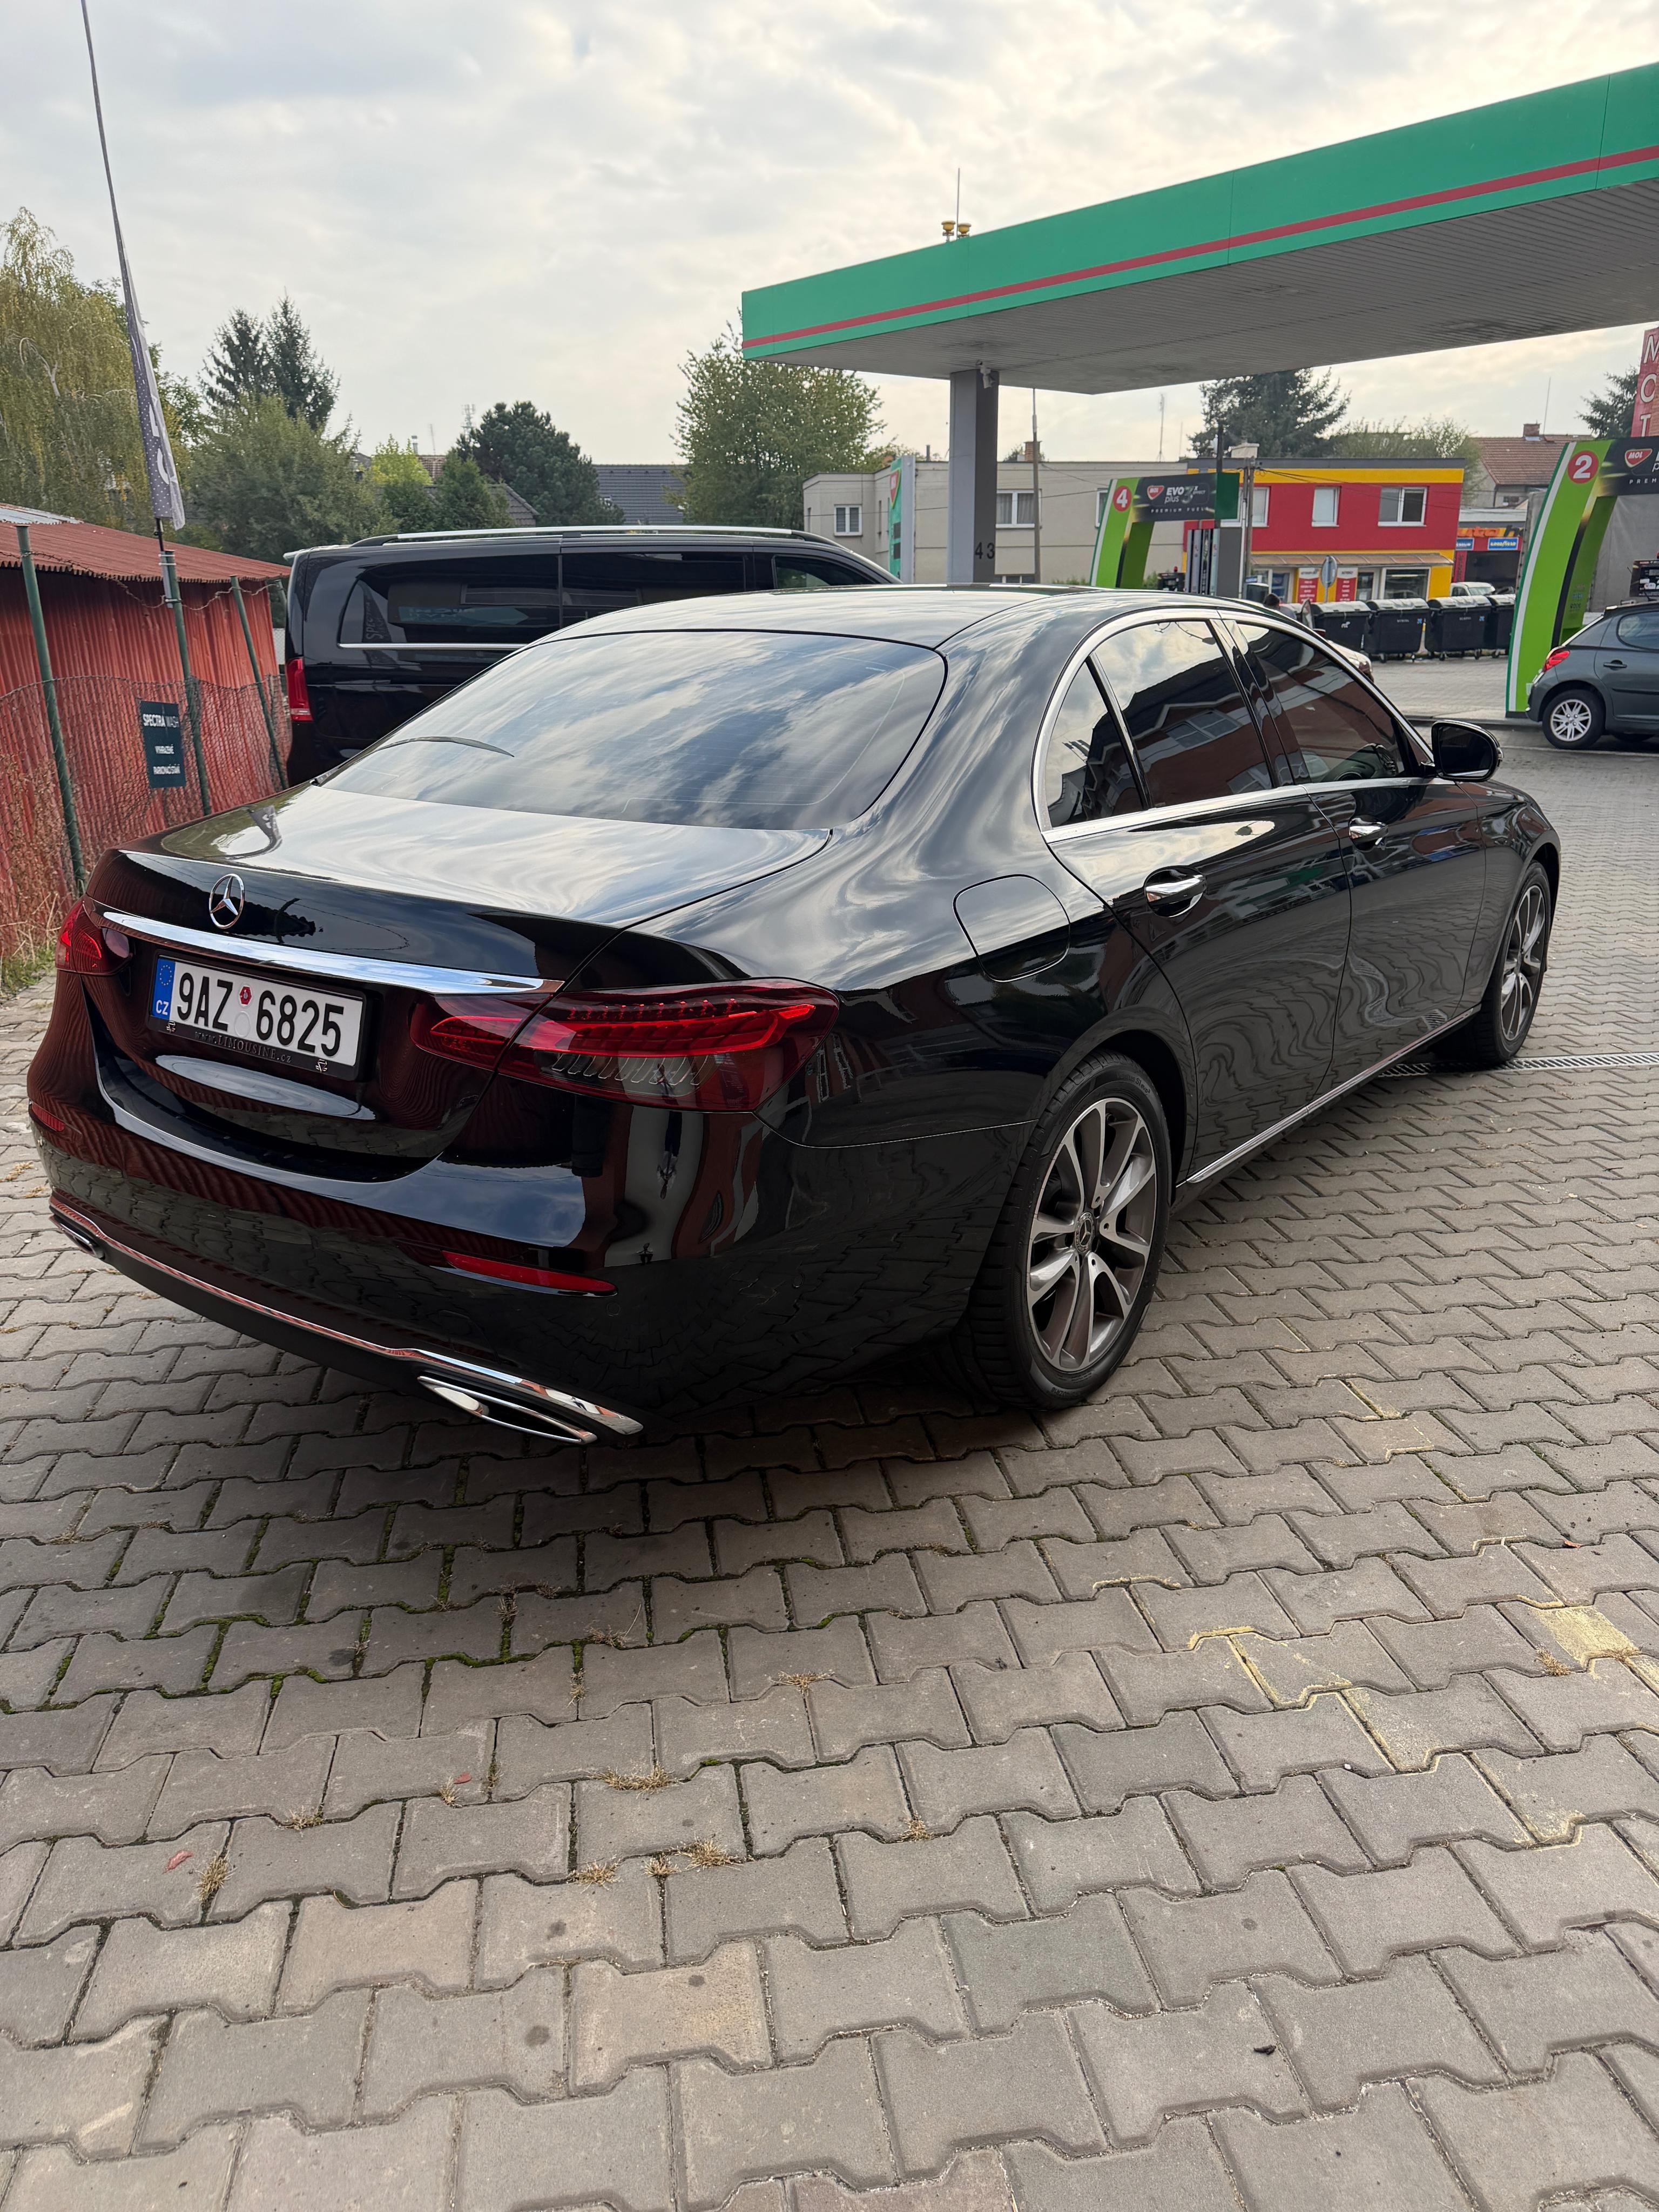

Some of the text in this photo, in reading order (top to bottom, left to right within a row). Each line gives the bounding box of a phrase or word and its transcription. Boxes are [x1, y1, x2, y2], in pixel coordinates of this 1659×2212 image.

[1573, 455, 1592, 479] 2
[1116, 489, 1128, 508] 4
[1164, 495, 1179, 504] plus
[1166, 487, 1184, 496] EVO
[975, 542, 995, 559] 43
[143, 713, 166, 727] SPECTRA
[156, 1000, 168, 1016] CZ
[177, 972, 345, 1057] 9AZ 6825
